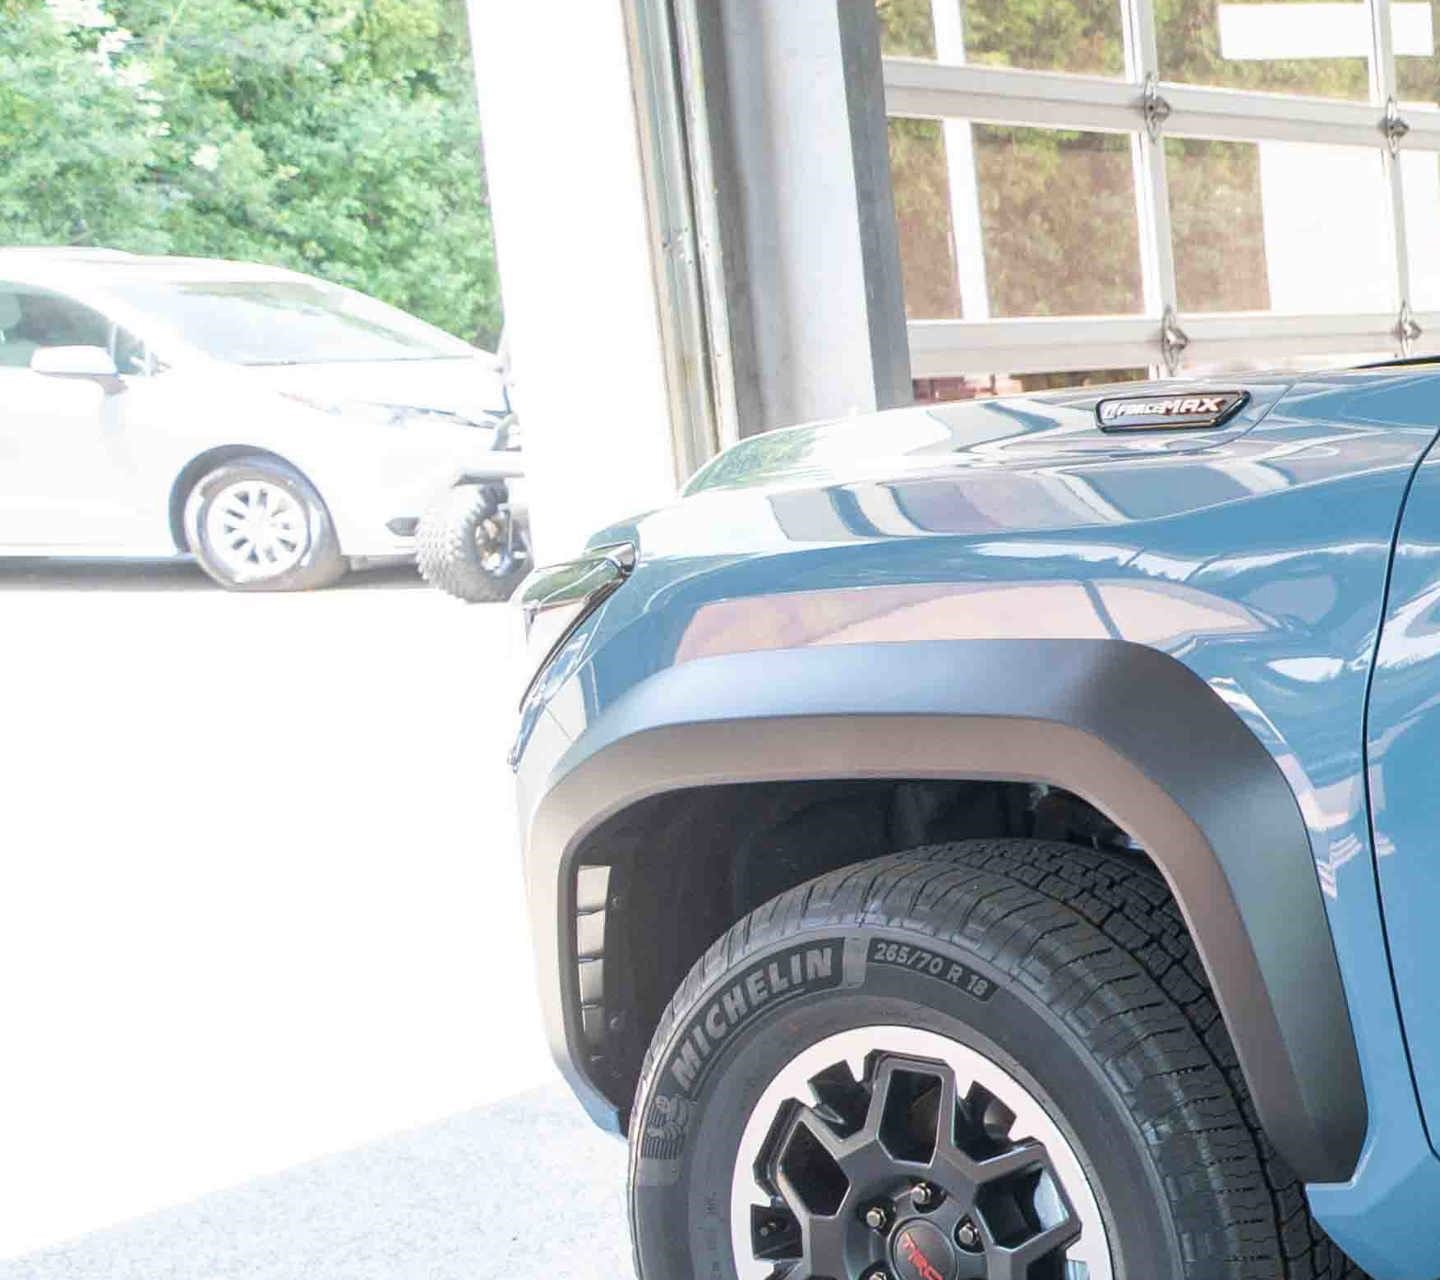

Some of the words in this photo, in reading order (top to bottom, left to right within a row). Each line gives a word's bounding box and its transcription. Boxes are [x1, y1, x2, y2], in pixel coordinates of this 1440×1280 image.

[670, 947, 833, 1089] MICHELIN
[874, 941, 943, 975] 265/70
[948, 963, 965, 983] R
[967, 971, 989, 998] 18
